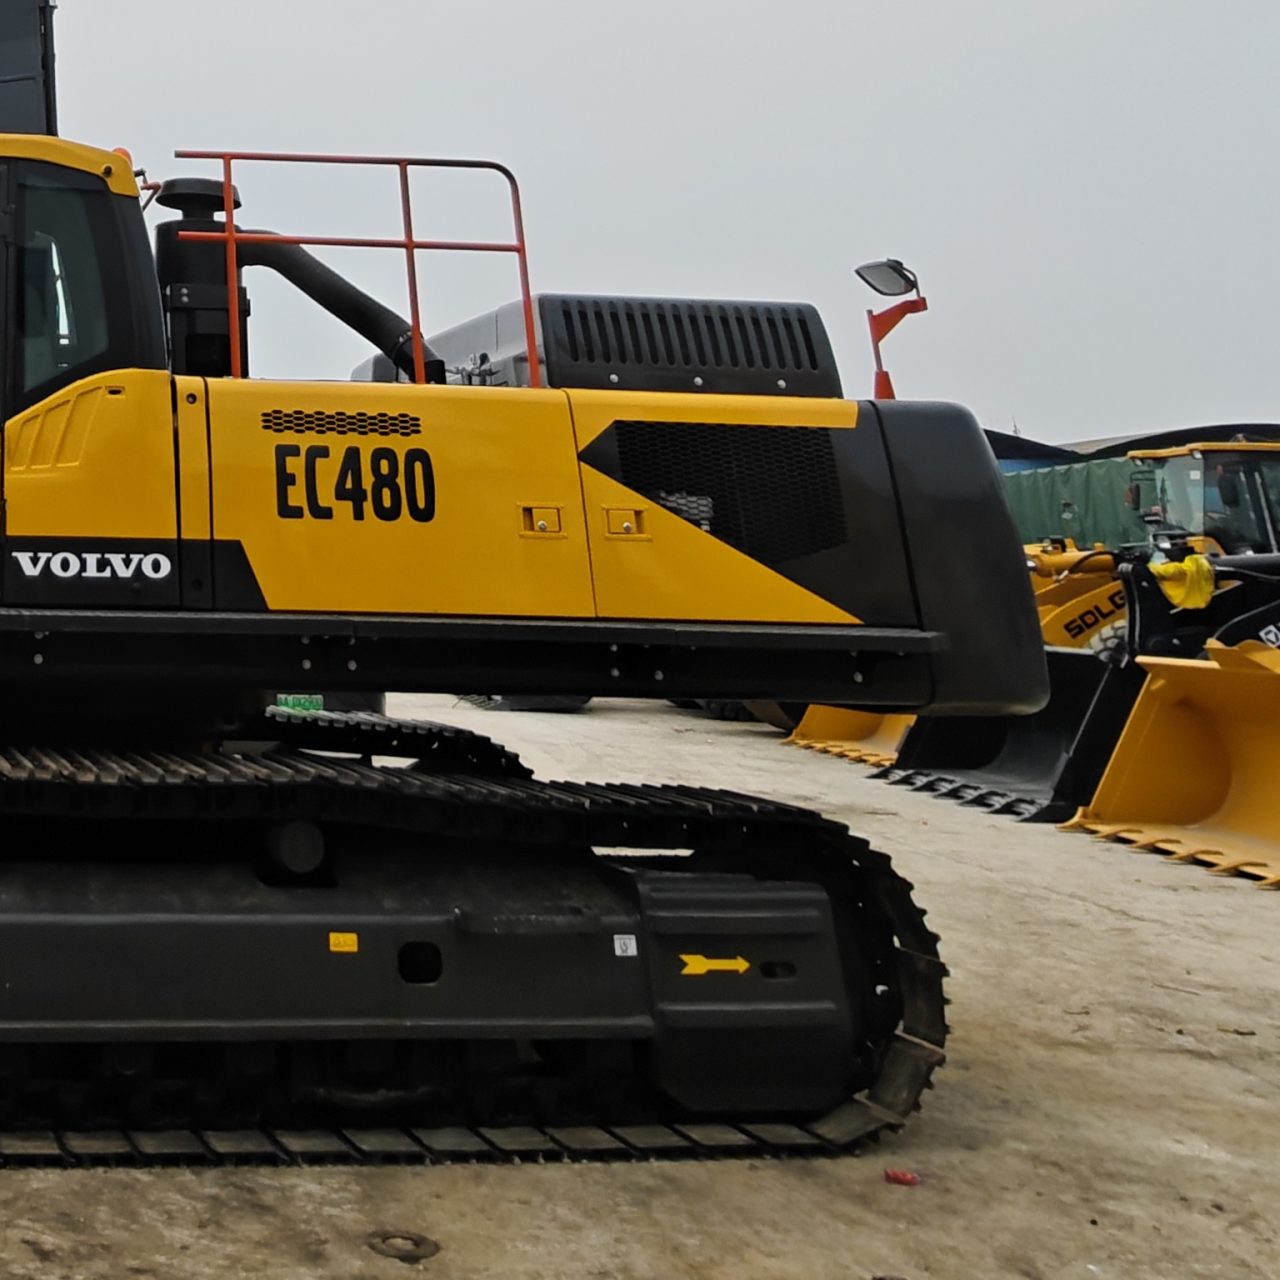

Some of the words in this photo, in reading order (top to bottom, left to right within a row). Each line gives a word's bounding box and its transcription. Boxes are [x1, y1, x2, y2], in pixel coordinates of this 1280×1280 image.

[275, 444, 435, 522] EC480
[12, 552, 171, 578] VOLVO
[1063, 589, 1125, 639] SDLG
